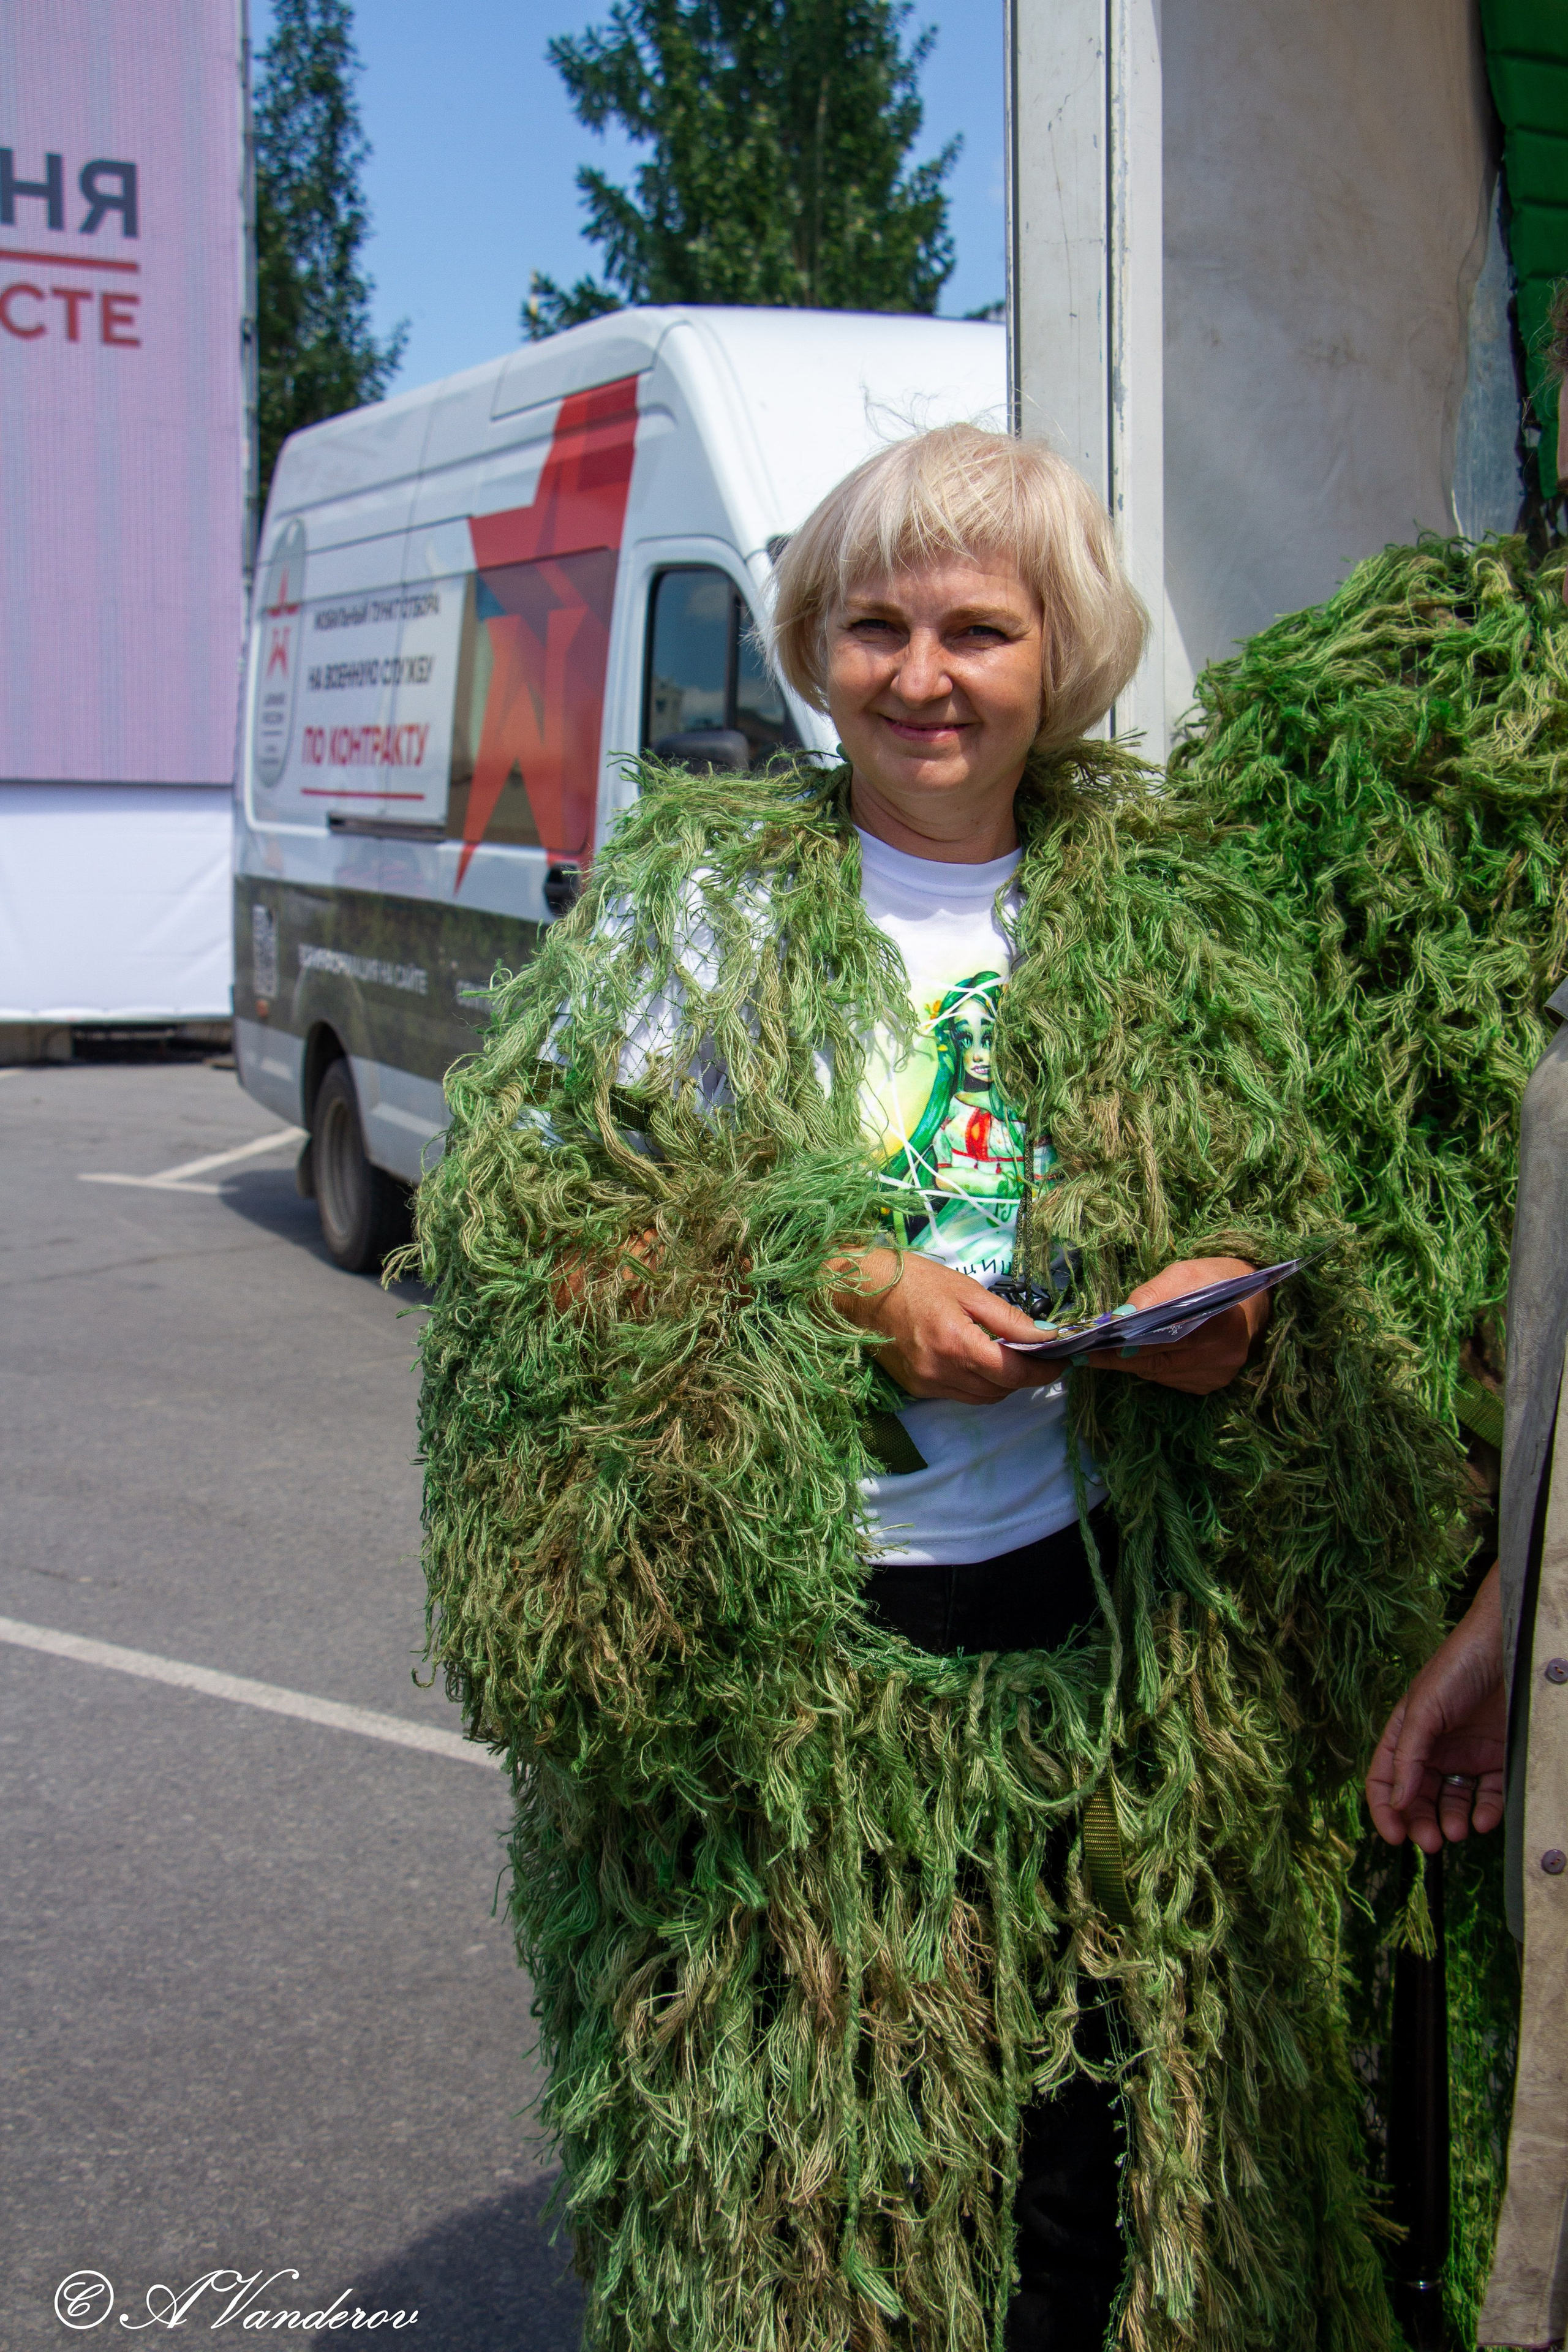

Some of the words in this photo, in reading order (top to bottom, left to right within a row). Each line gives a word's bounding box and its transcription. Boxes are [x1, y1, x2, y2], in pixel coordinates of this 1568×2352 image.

[0, 148, 138, 238] НЯ
[0, 282, 140, 347] СТЕ
[302, 725, 325, 763] ПО
[328, 723, 430, 766] КОНТРАКТУ
